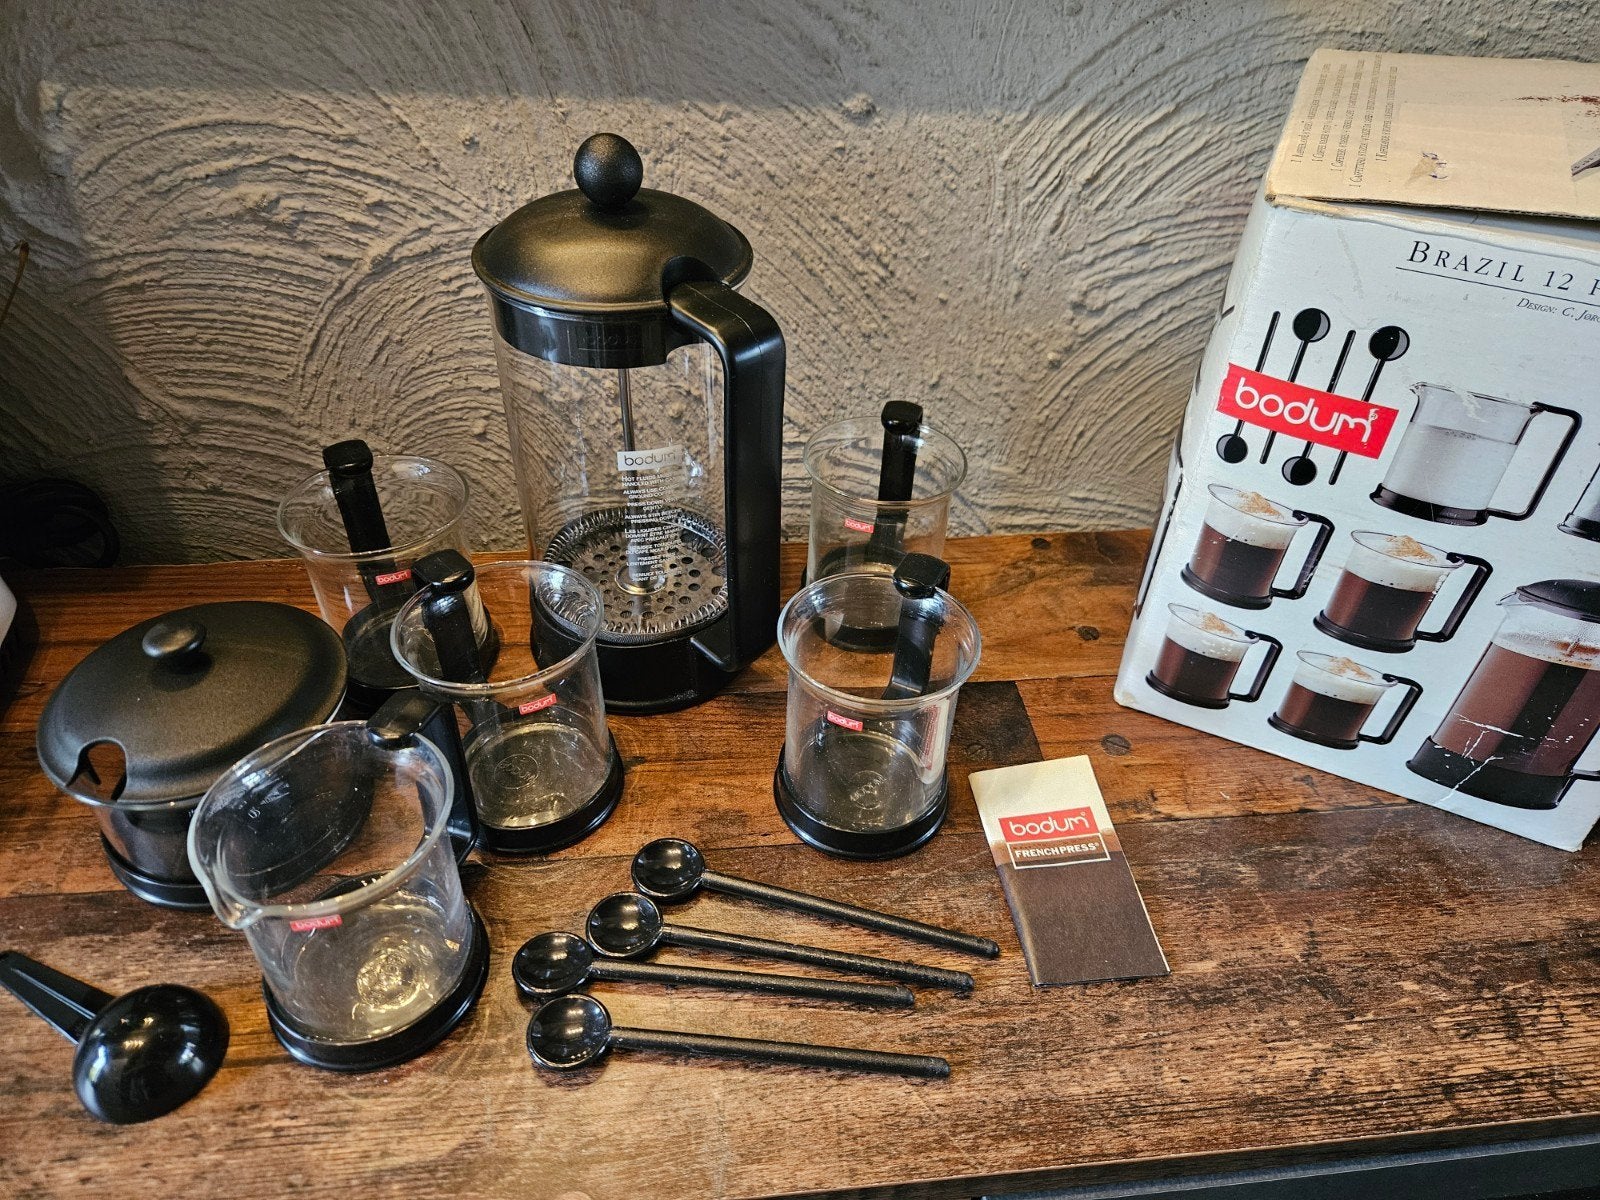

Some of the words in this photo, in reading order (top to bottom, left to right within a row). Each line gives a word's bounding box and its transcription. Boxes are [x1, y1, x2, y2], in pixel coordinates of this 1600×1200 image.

[1407, 240, 1524, 282] BRAZIL
[1543, 271, 1573, 290] 12
[1516, 298, 1557, 313] DESIGN:
[1562, 307, 1574, 318] C.
[1235, 377, 1373, 442] bodum
[624, 452, 676, 466] bodum
[378, 571, 408, 583] bodum
[521, 697, 553, 711] bodum
[1009, 816, 1090, 836] bodum
